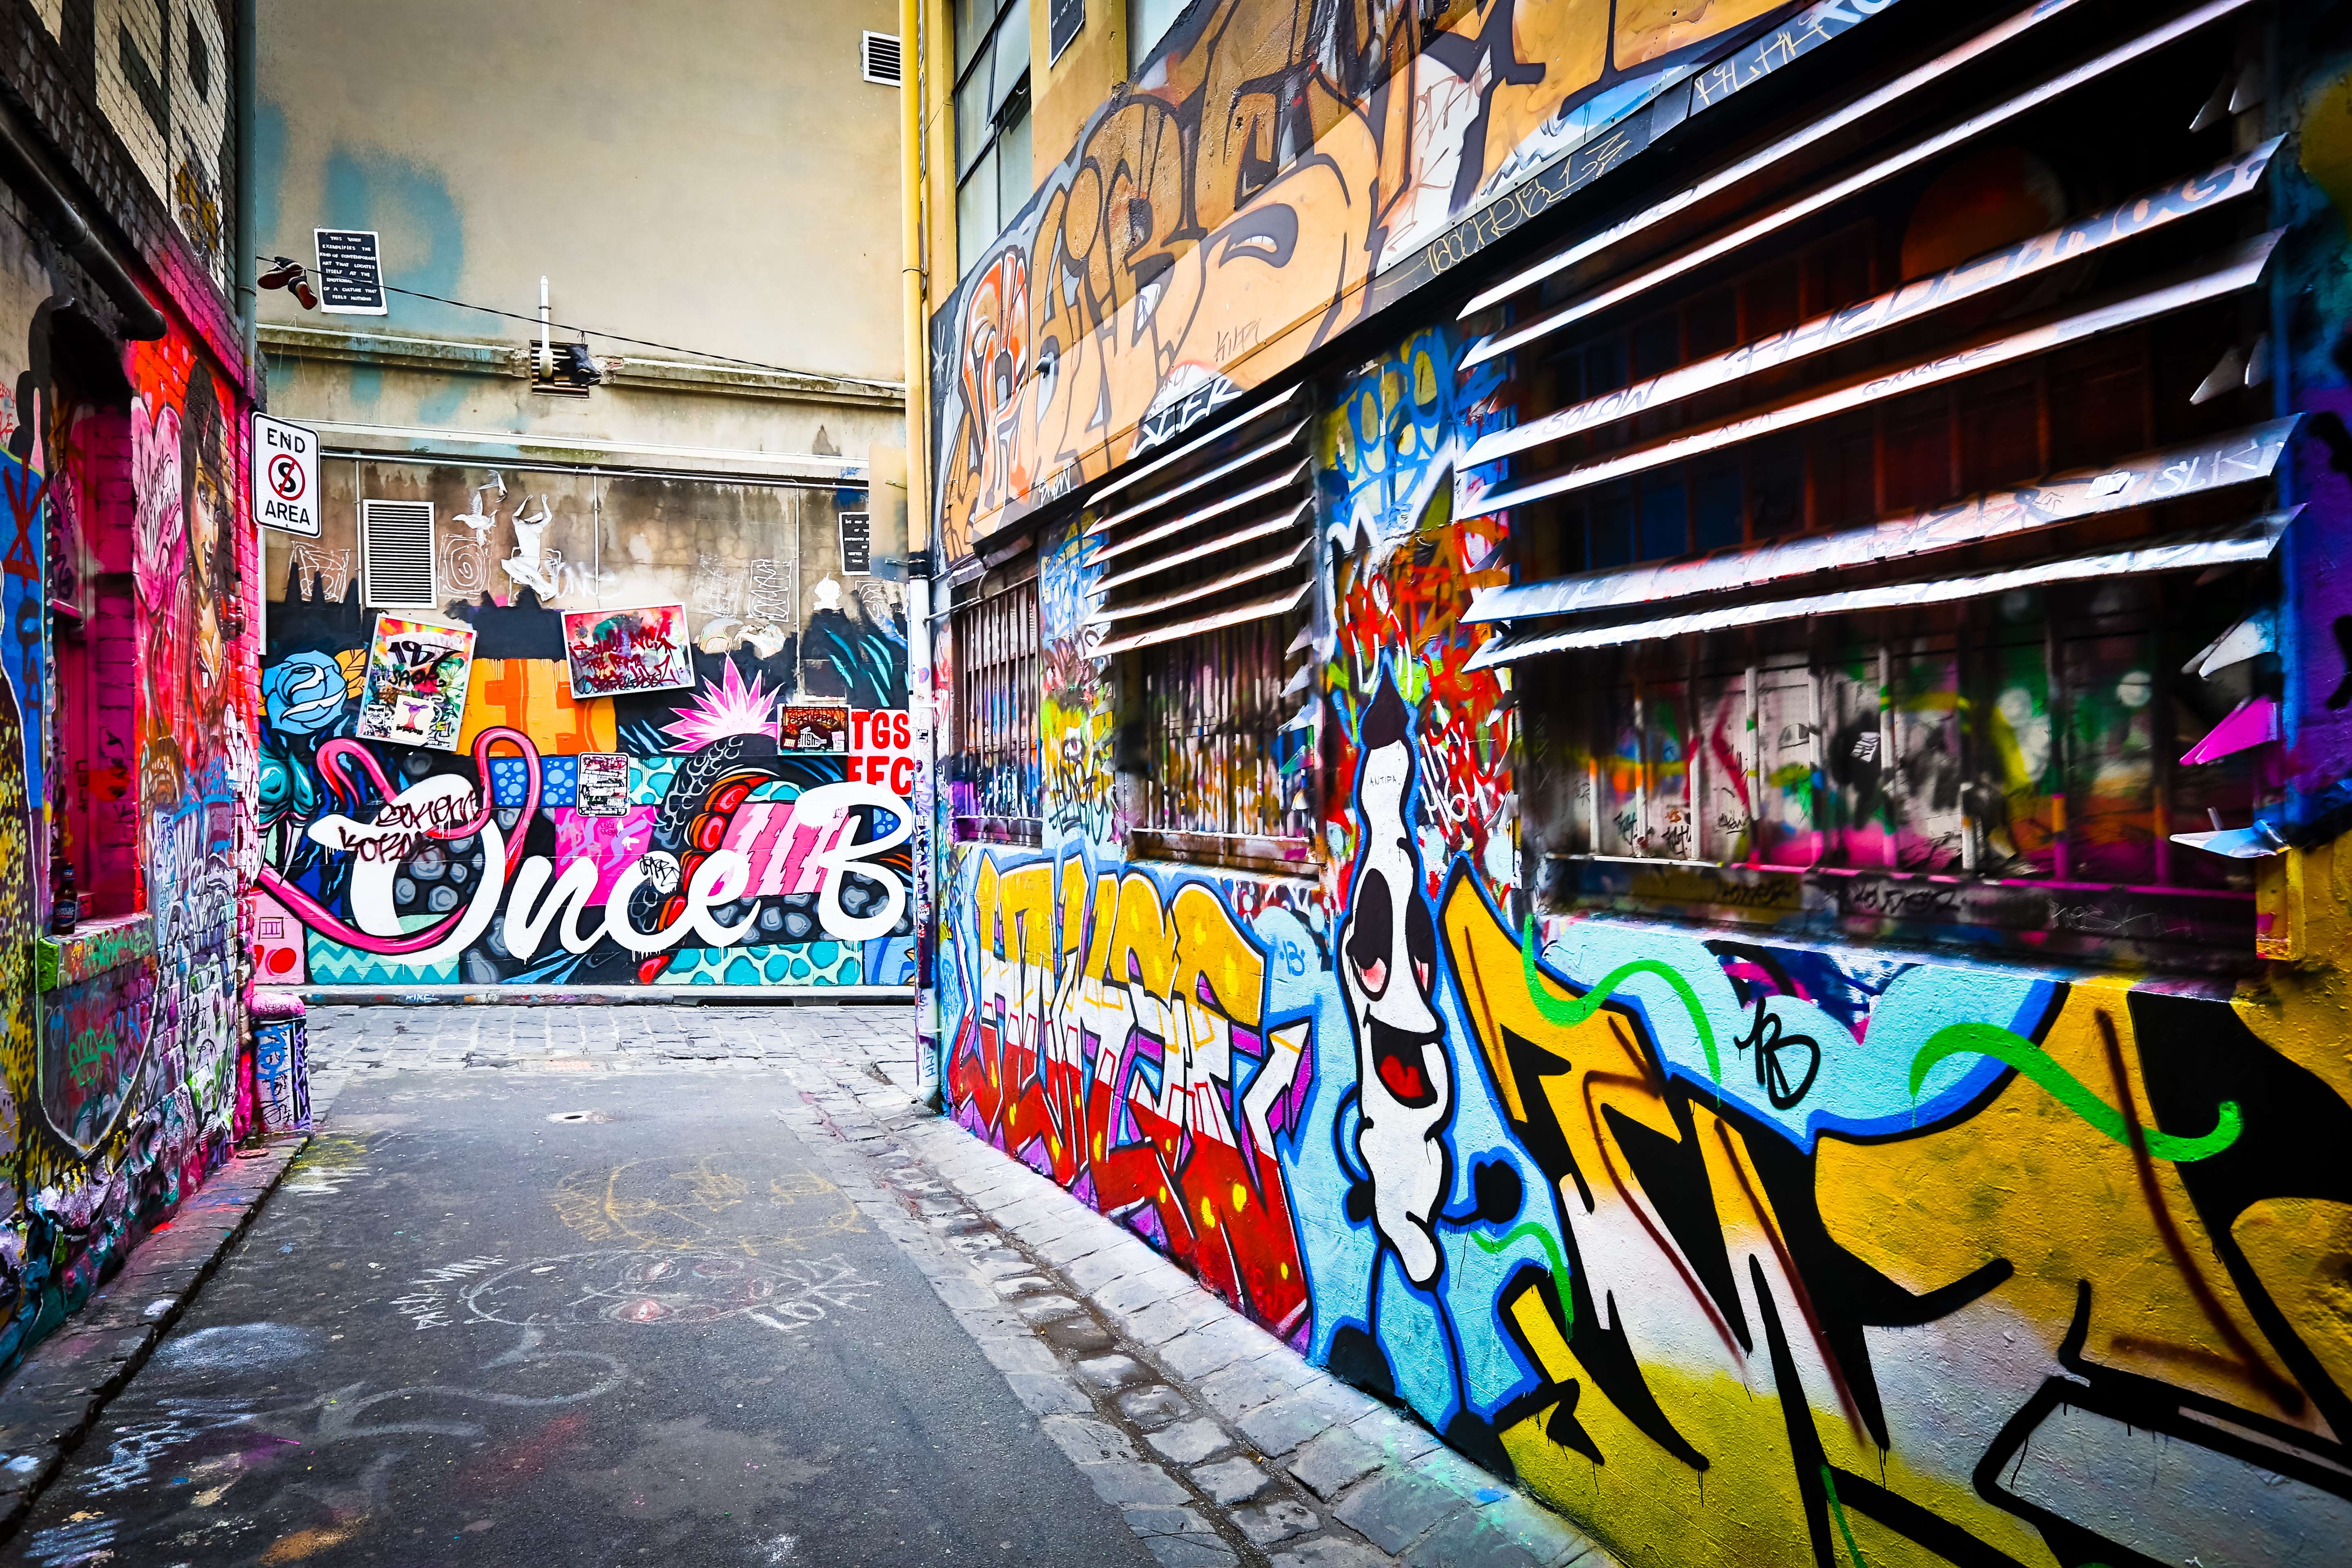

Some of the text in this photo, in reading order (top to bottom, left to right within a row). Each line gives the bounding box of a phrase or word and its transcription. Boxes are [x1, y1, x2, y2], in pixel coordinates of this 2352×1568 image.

[267, 428, 305, 453] END
[265, 500, 310, 526] AREA
[851, 712, 911, 749] TGS
[308, 774, 761, 965] Once
[795, 782, 913, 941] B
